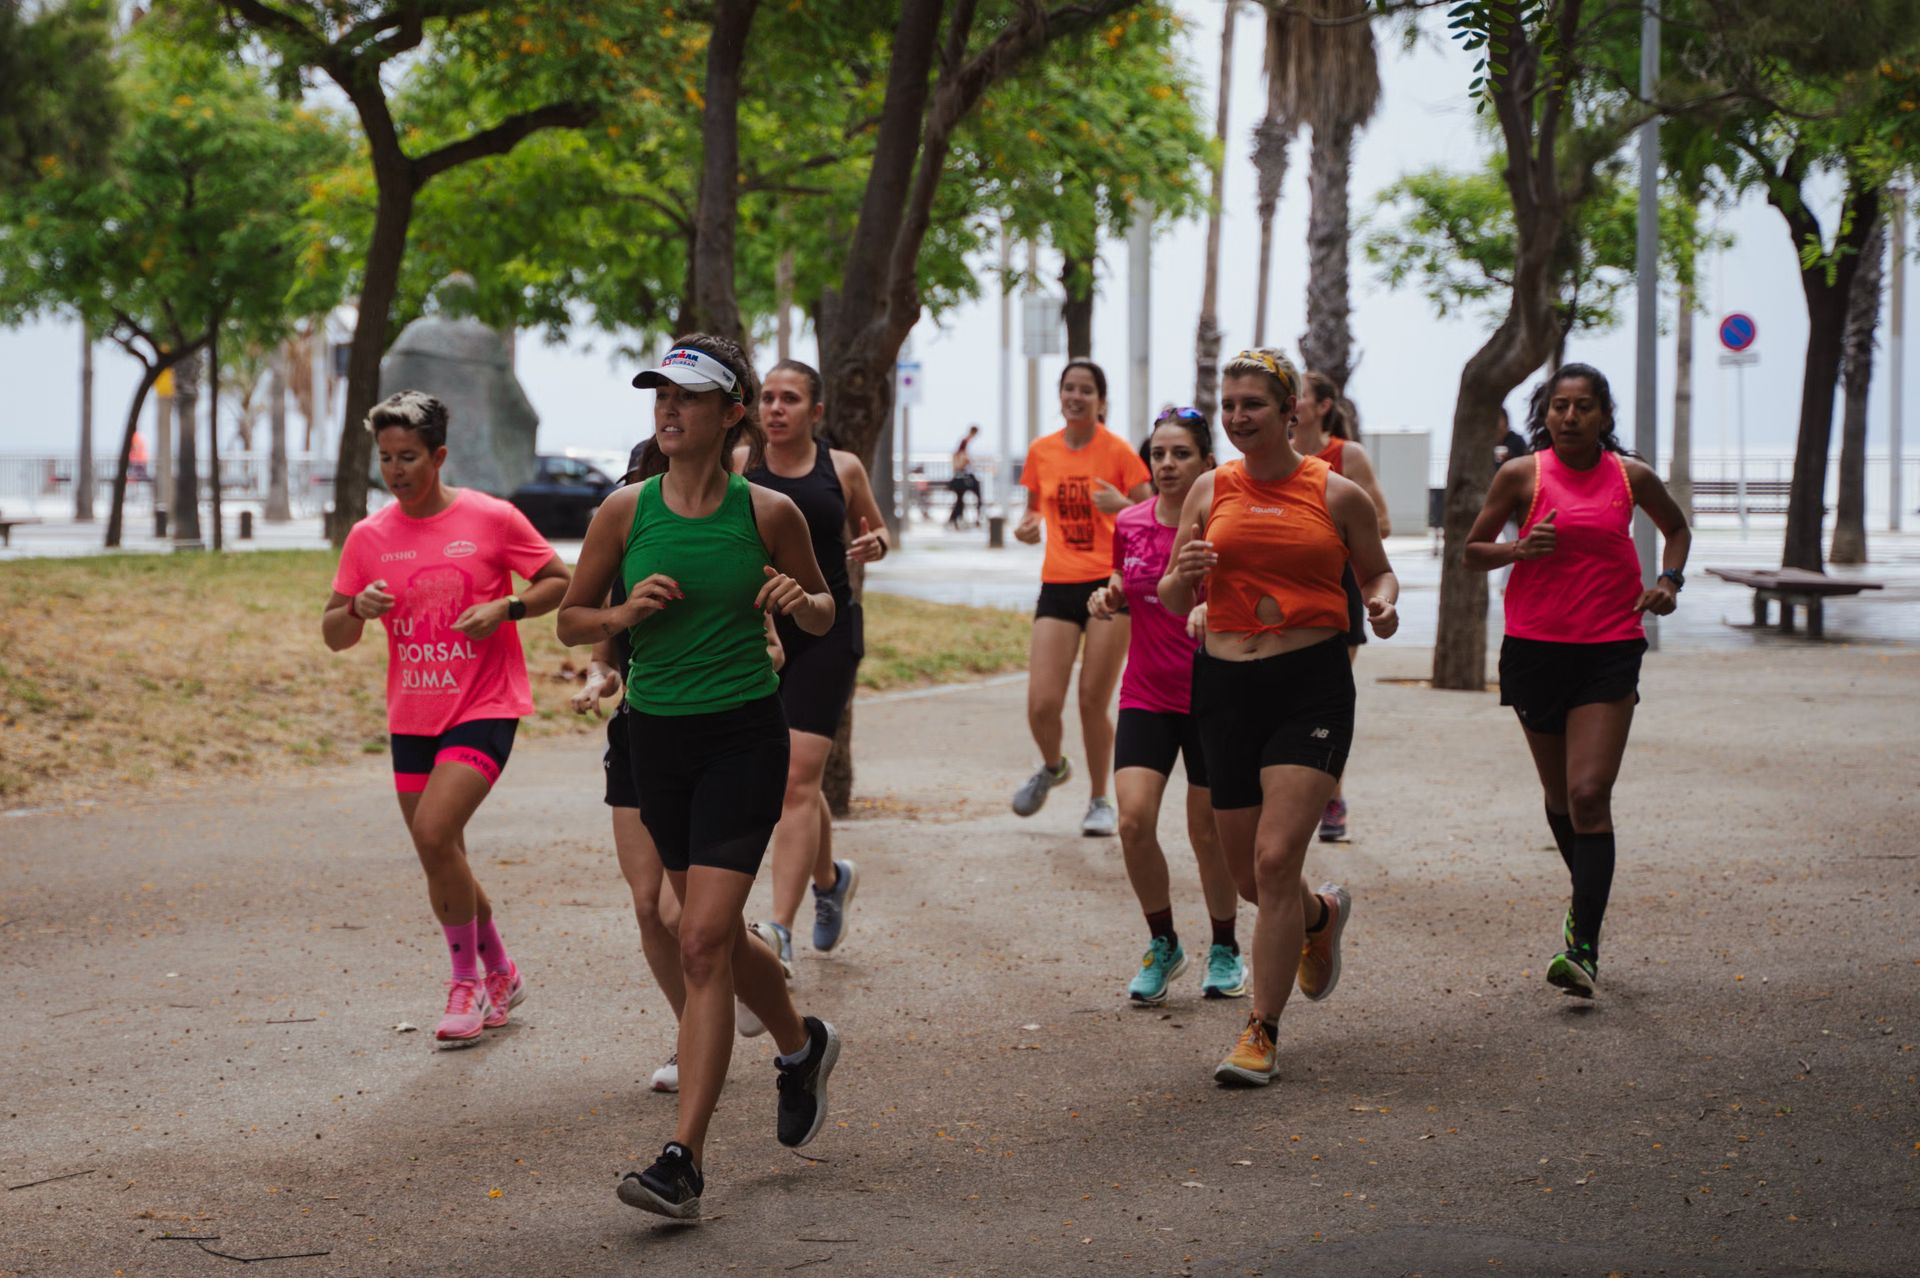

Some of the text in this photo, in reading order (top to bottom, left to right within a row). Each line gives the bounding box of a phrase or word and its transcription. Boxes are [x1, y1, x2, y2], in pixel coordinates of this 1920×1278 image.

[1058, 503, 1092, 520] RUN
[381, 550, 417, 562] OYSHO
[392, 616, 414, 637] TU
[397, 640, 477, 663] DORSAL
[402, 669, 458, 688] SUMA
